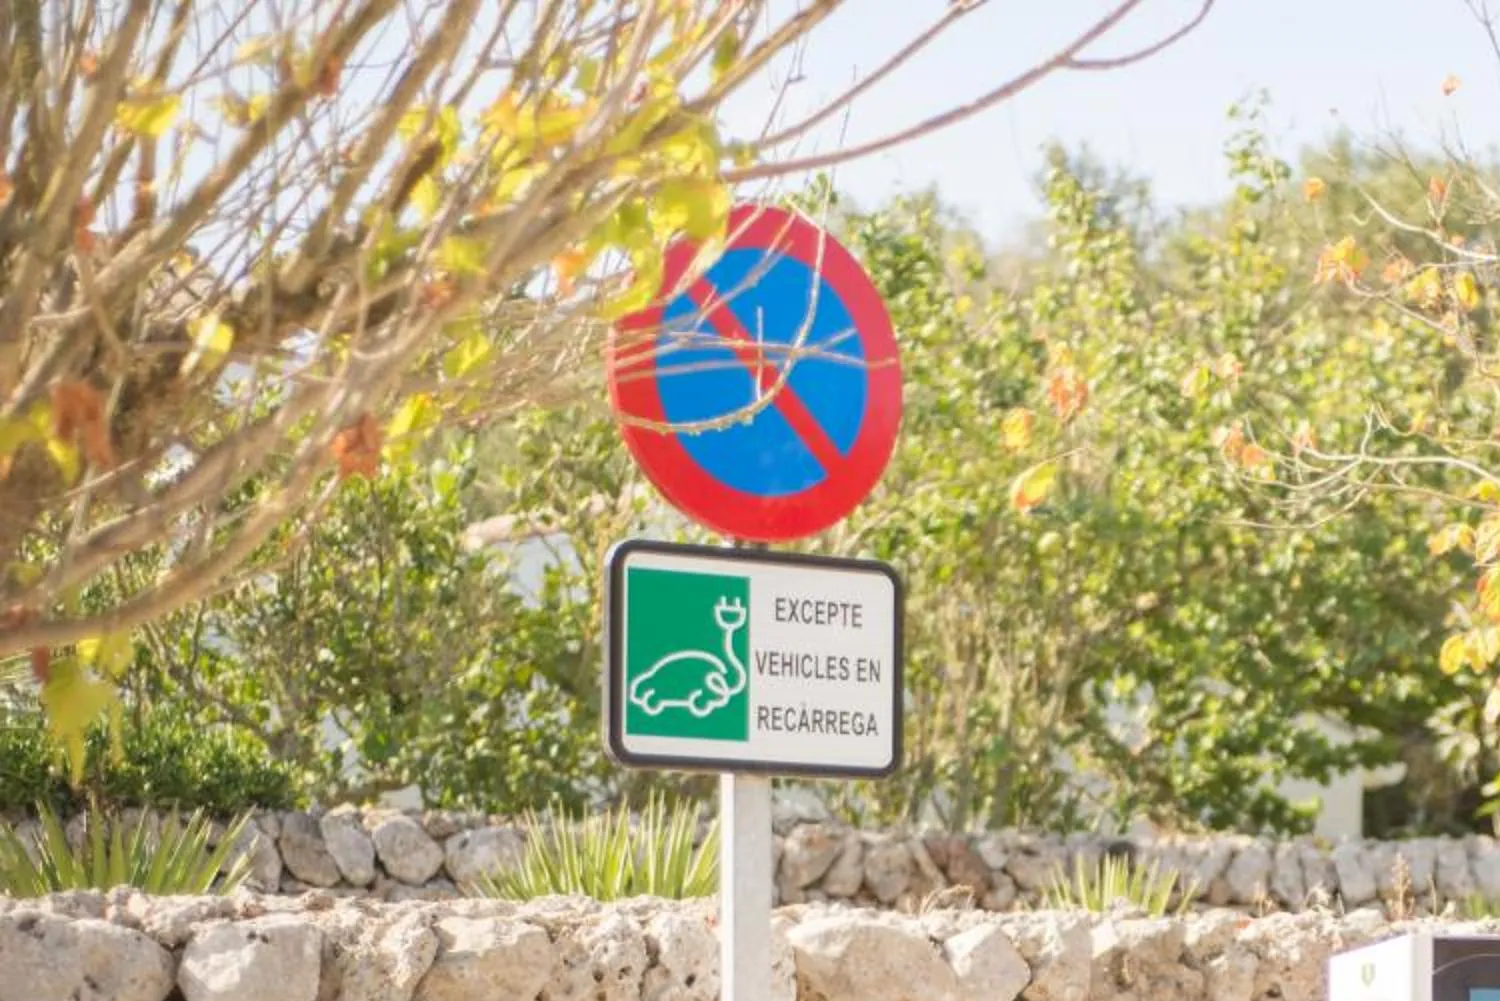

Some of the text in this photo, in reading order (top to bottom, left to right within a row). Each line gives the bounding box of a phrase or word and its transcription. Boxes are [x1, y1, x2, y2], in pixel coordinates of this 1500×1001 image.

[775, 597, 863, 629] EXCEPTE
[755, 650, 881, 683] VEHICLES EN
